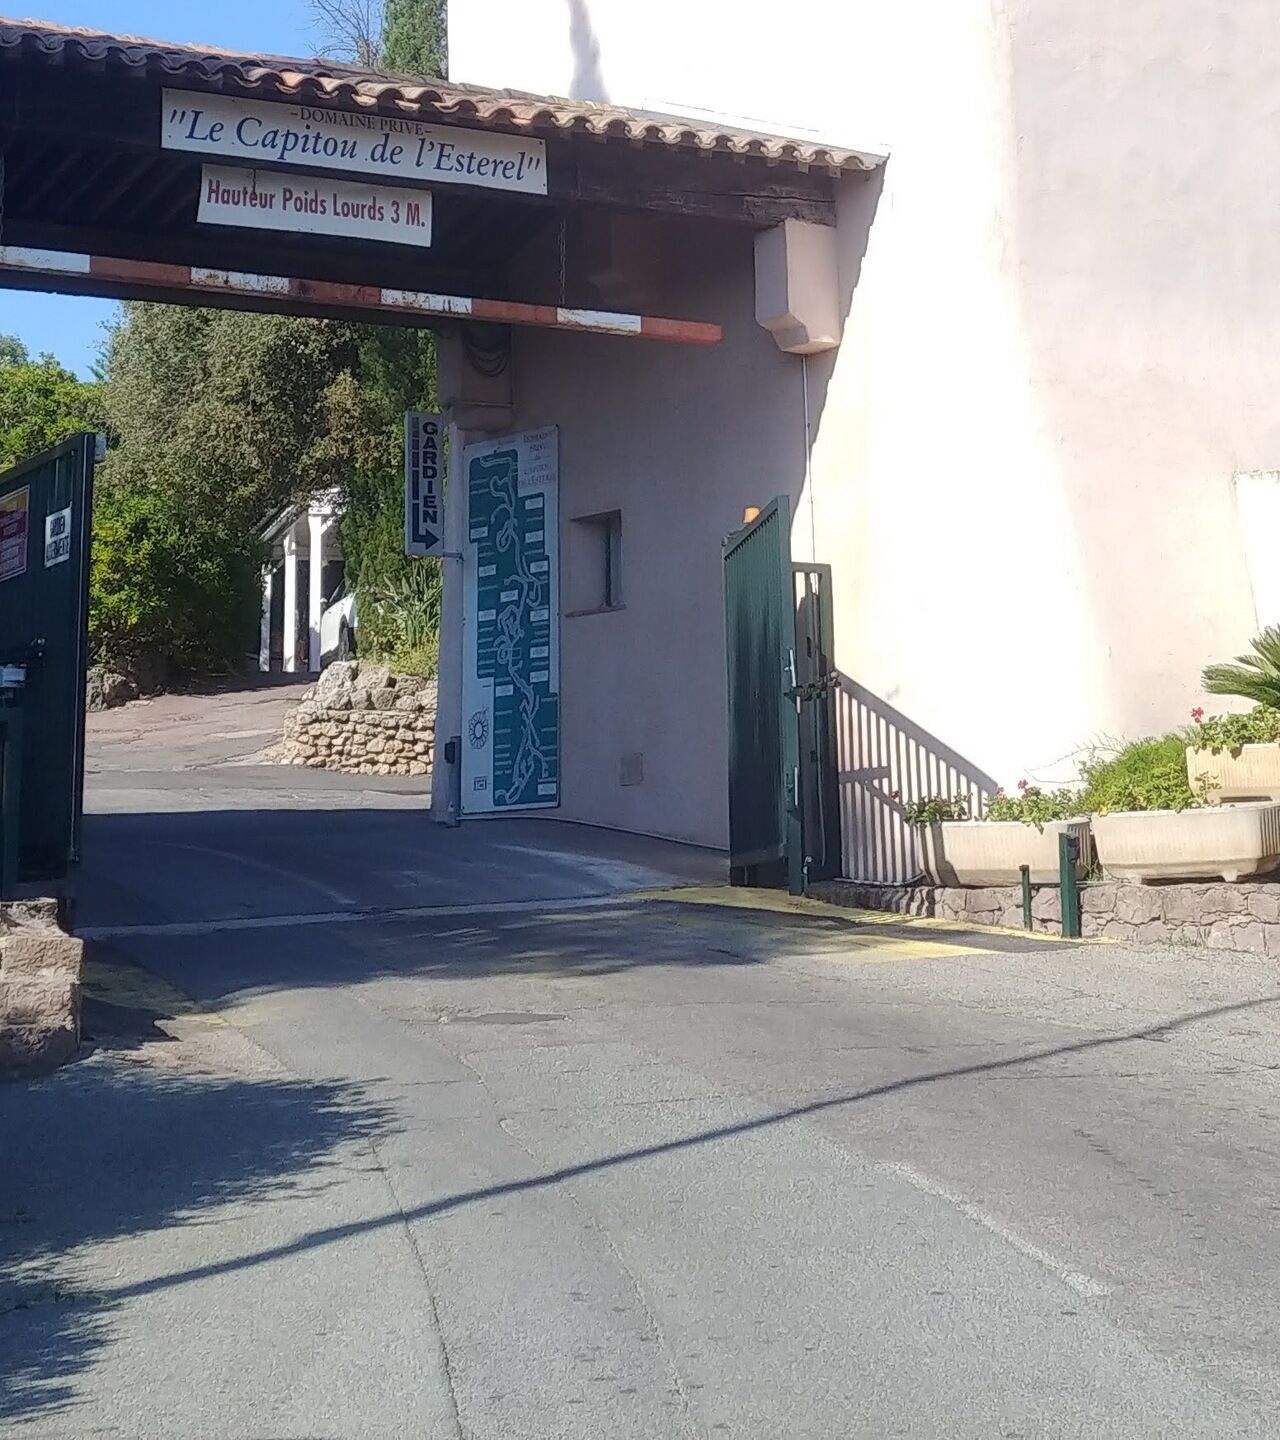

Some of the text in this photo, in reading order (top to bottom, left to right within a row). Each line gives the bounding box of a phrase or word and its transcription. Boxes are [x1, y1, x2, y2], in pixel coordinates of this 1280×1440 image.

[170, 109, 224, 142] "Le
[236, 116, 357, 160] Capitou
[370, 133, 404, 165] de
[206, 179, 426, 228] Hauteur Poids Lourds 3 M.
[422, 421, 438, 524] GARDIEN
